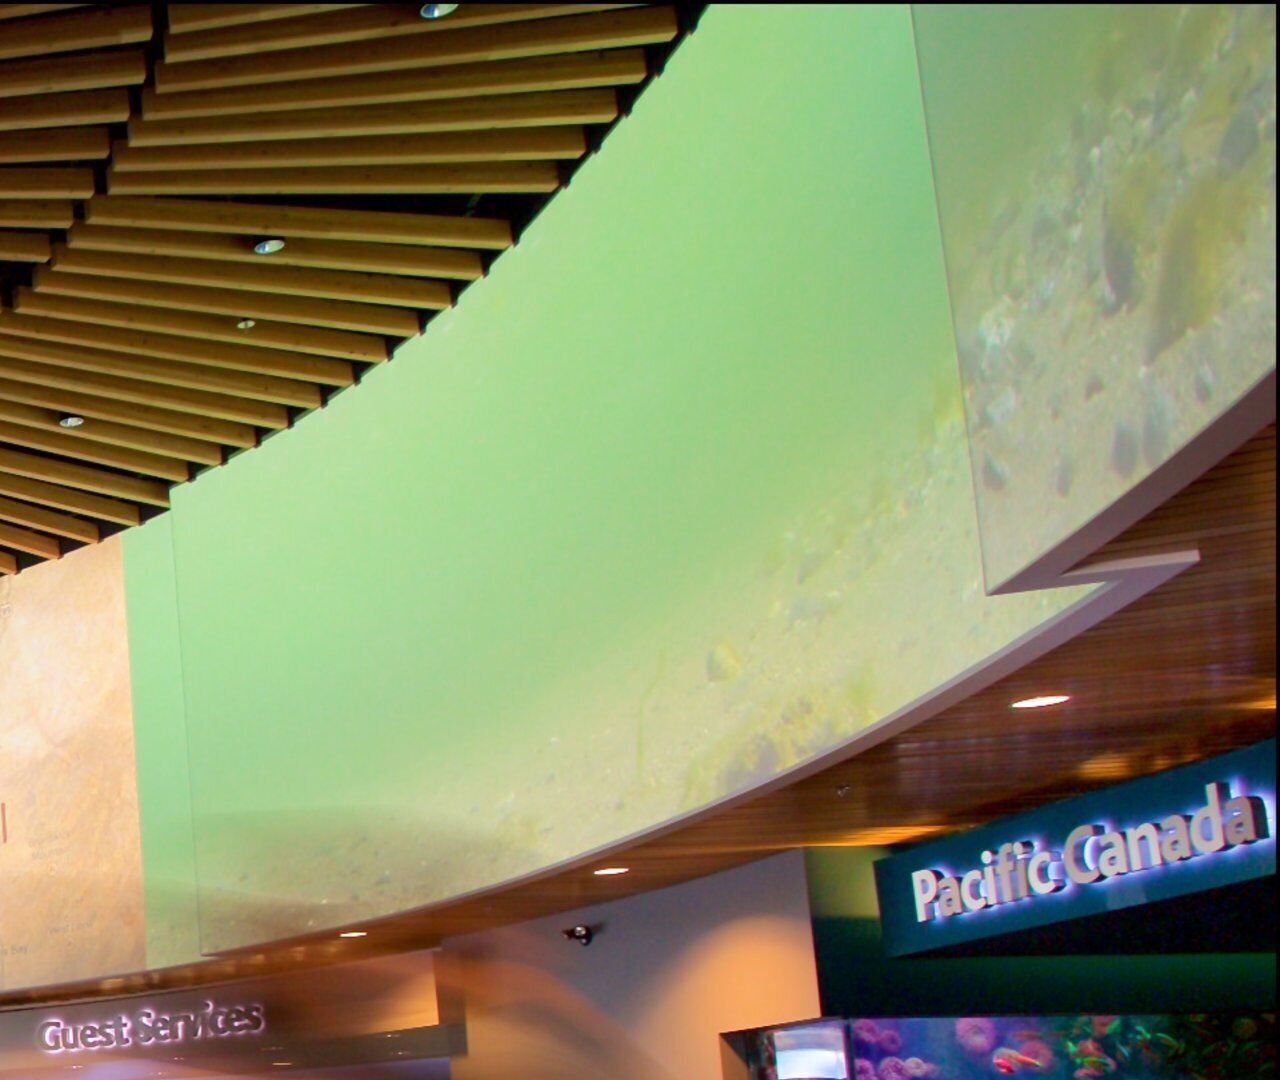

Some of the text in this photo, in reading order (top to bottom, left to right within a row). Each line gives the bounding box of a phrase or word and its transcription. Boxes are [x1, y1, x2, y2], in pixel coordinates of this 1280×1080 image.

[911, 781, 1257, 923] Pacific Canada
[41, 1001, 264, 1051] Guest Services
